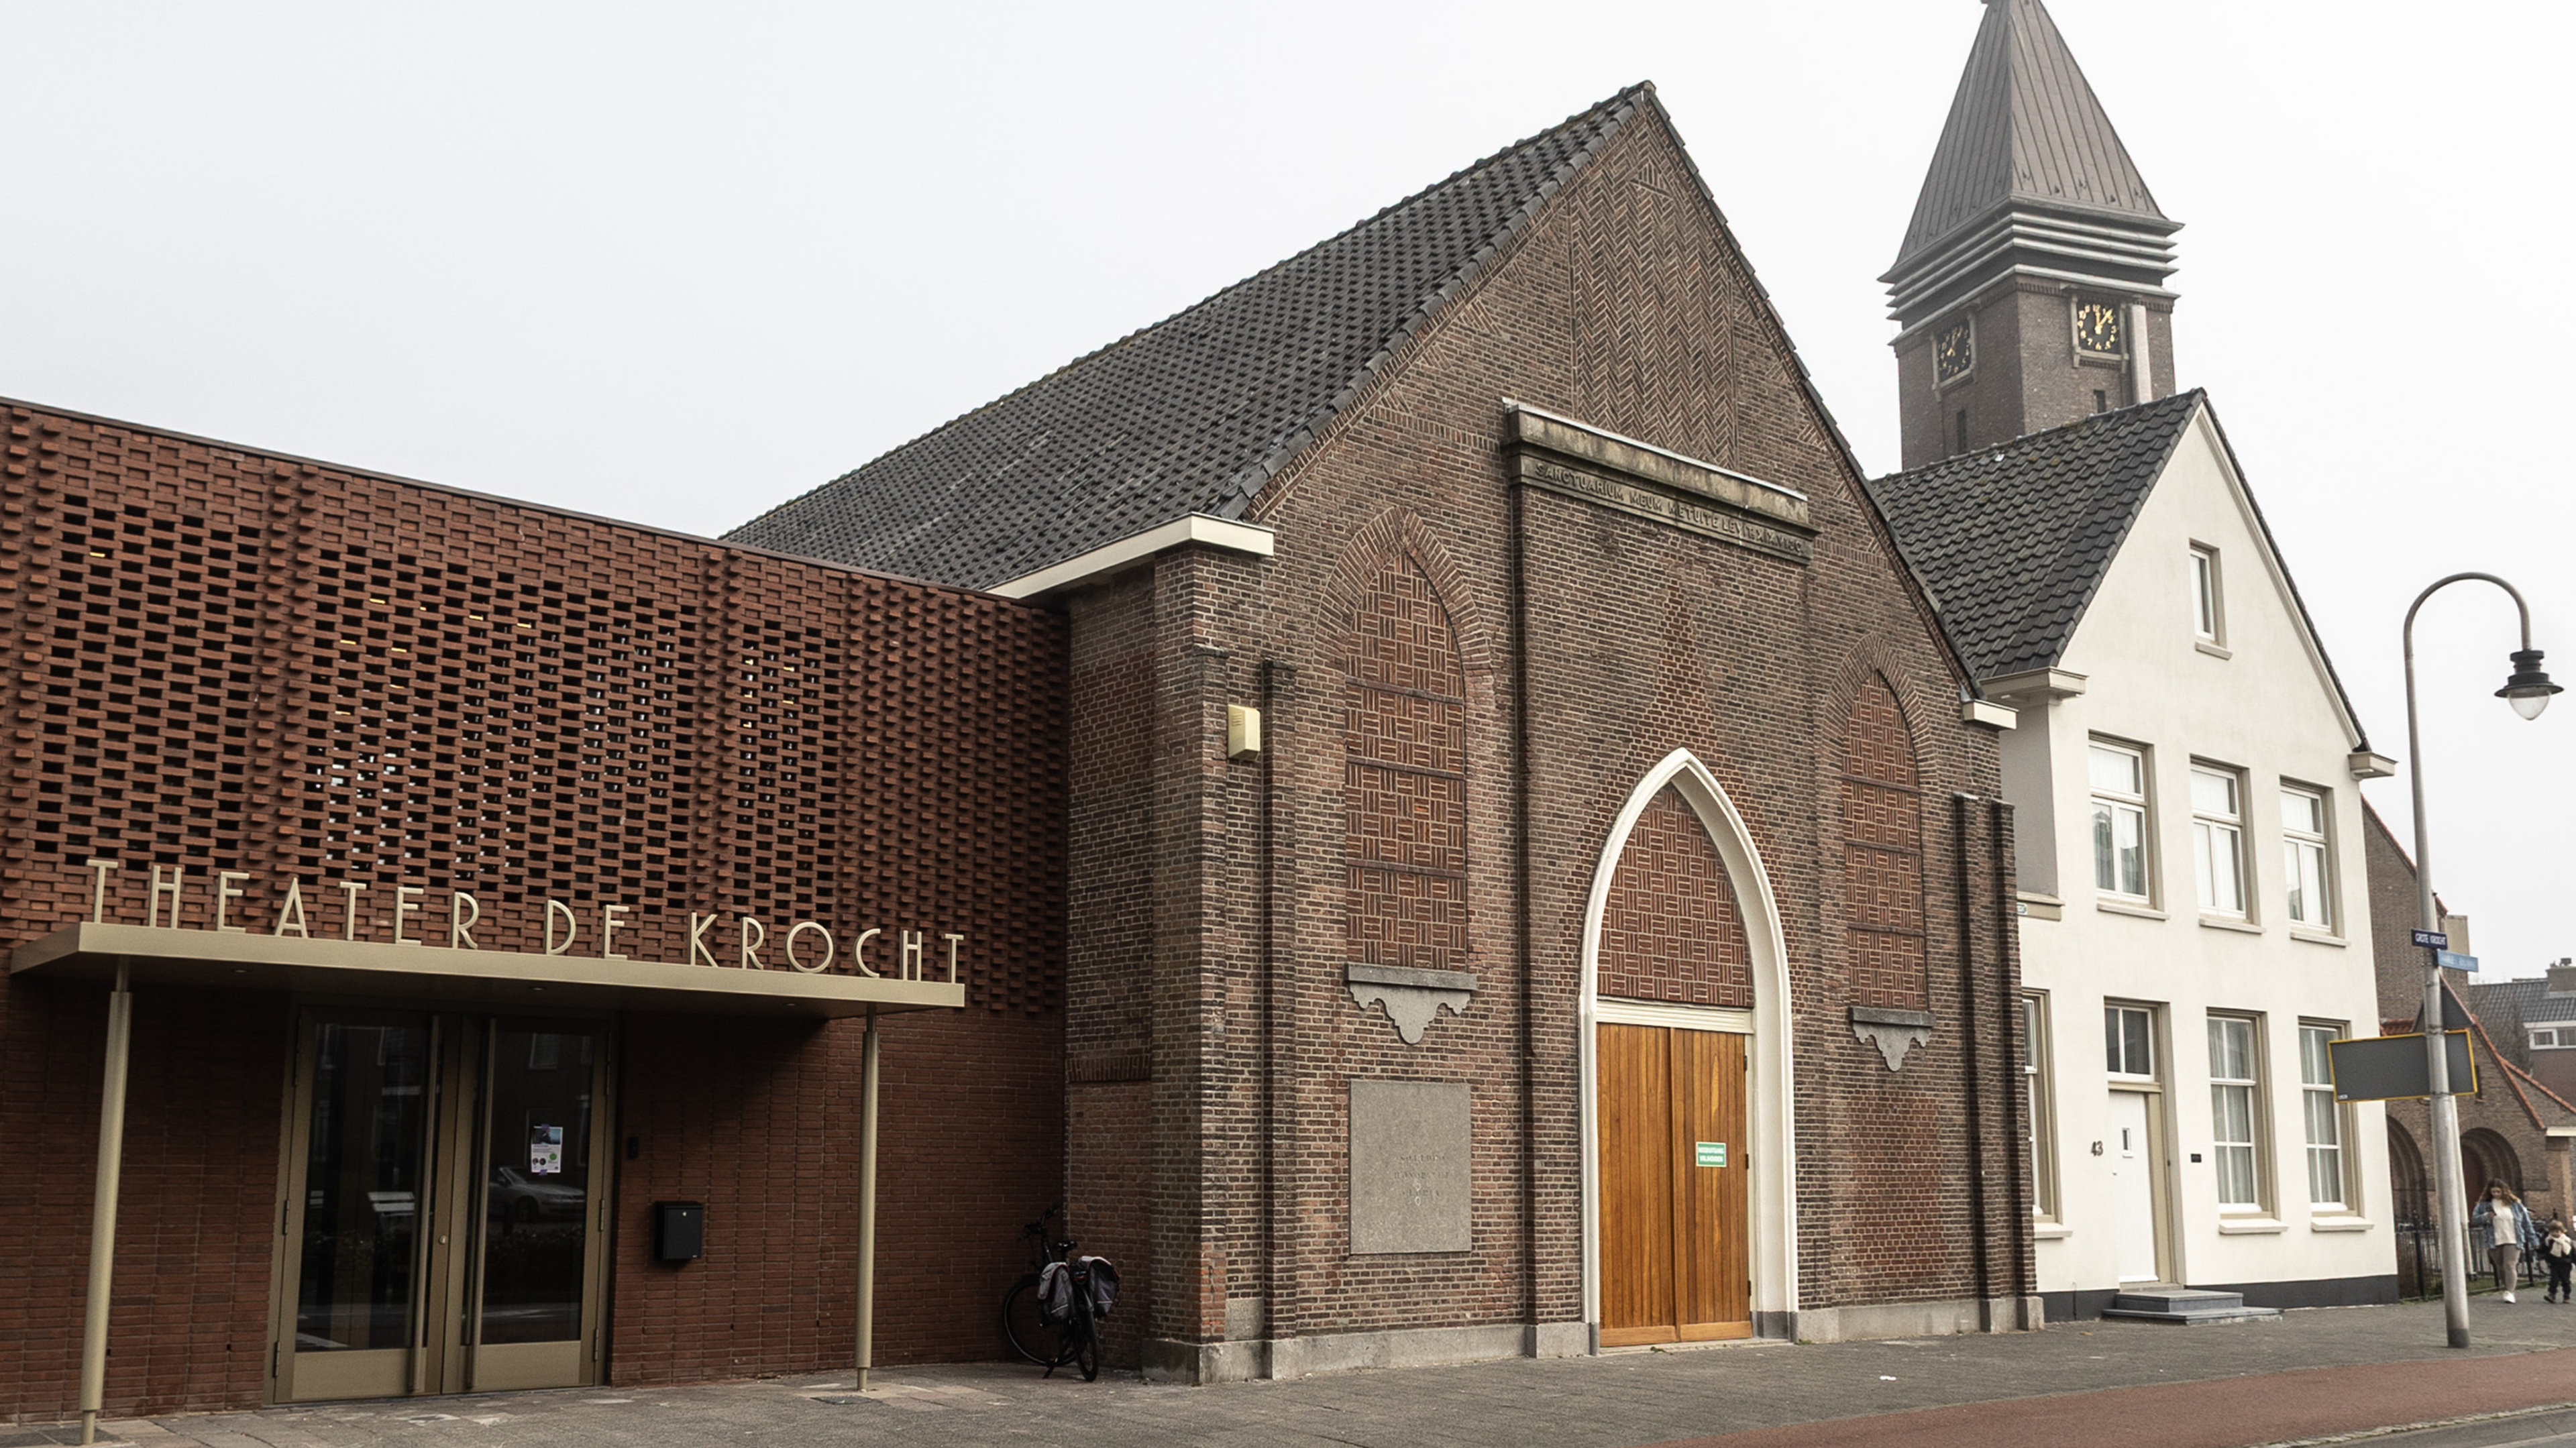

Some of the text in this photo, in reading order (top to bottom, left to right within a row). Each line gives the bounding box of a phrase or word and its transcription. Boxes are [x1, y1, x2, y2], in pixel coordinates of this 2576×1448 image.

[1535, 462, 1624, 501] SANCTUARIUM
[1629, 491, 1662, 512] MEUM
[1668, 501, 1719, 528] METUITE
[87, 858, 964, 983] THEATER DE KROCHT
[2090, 1140, 2104, 1156] 43
